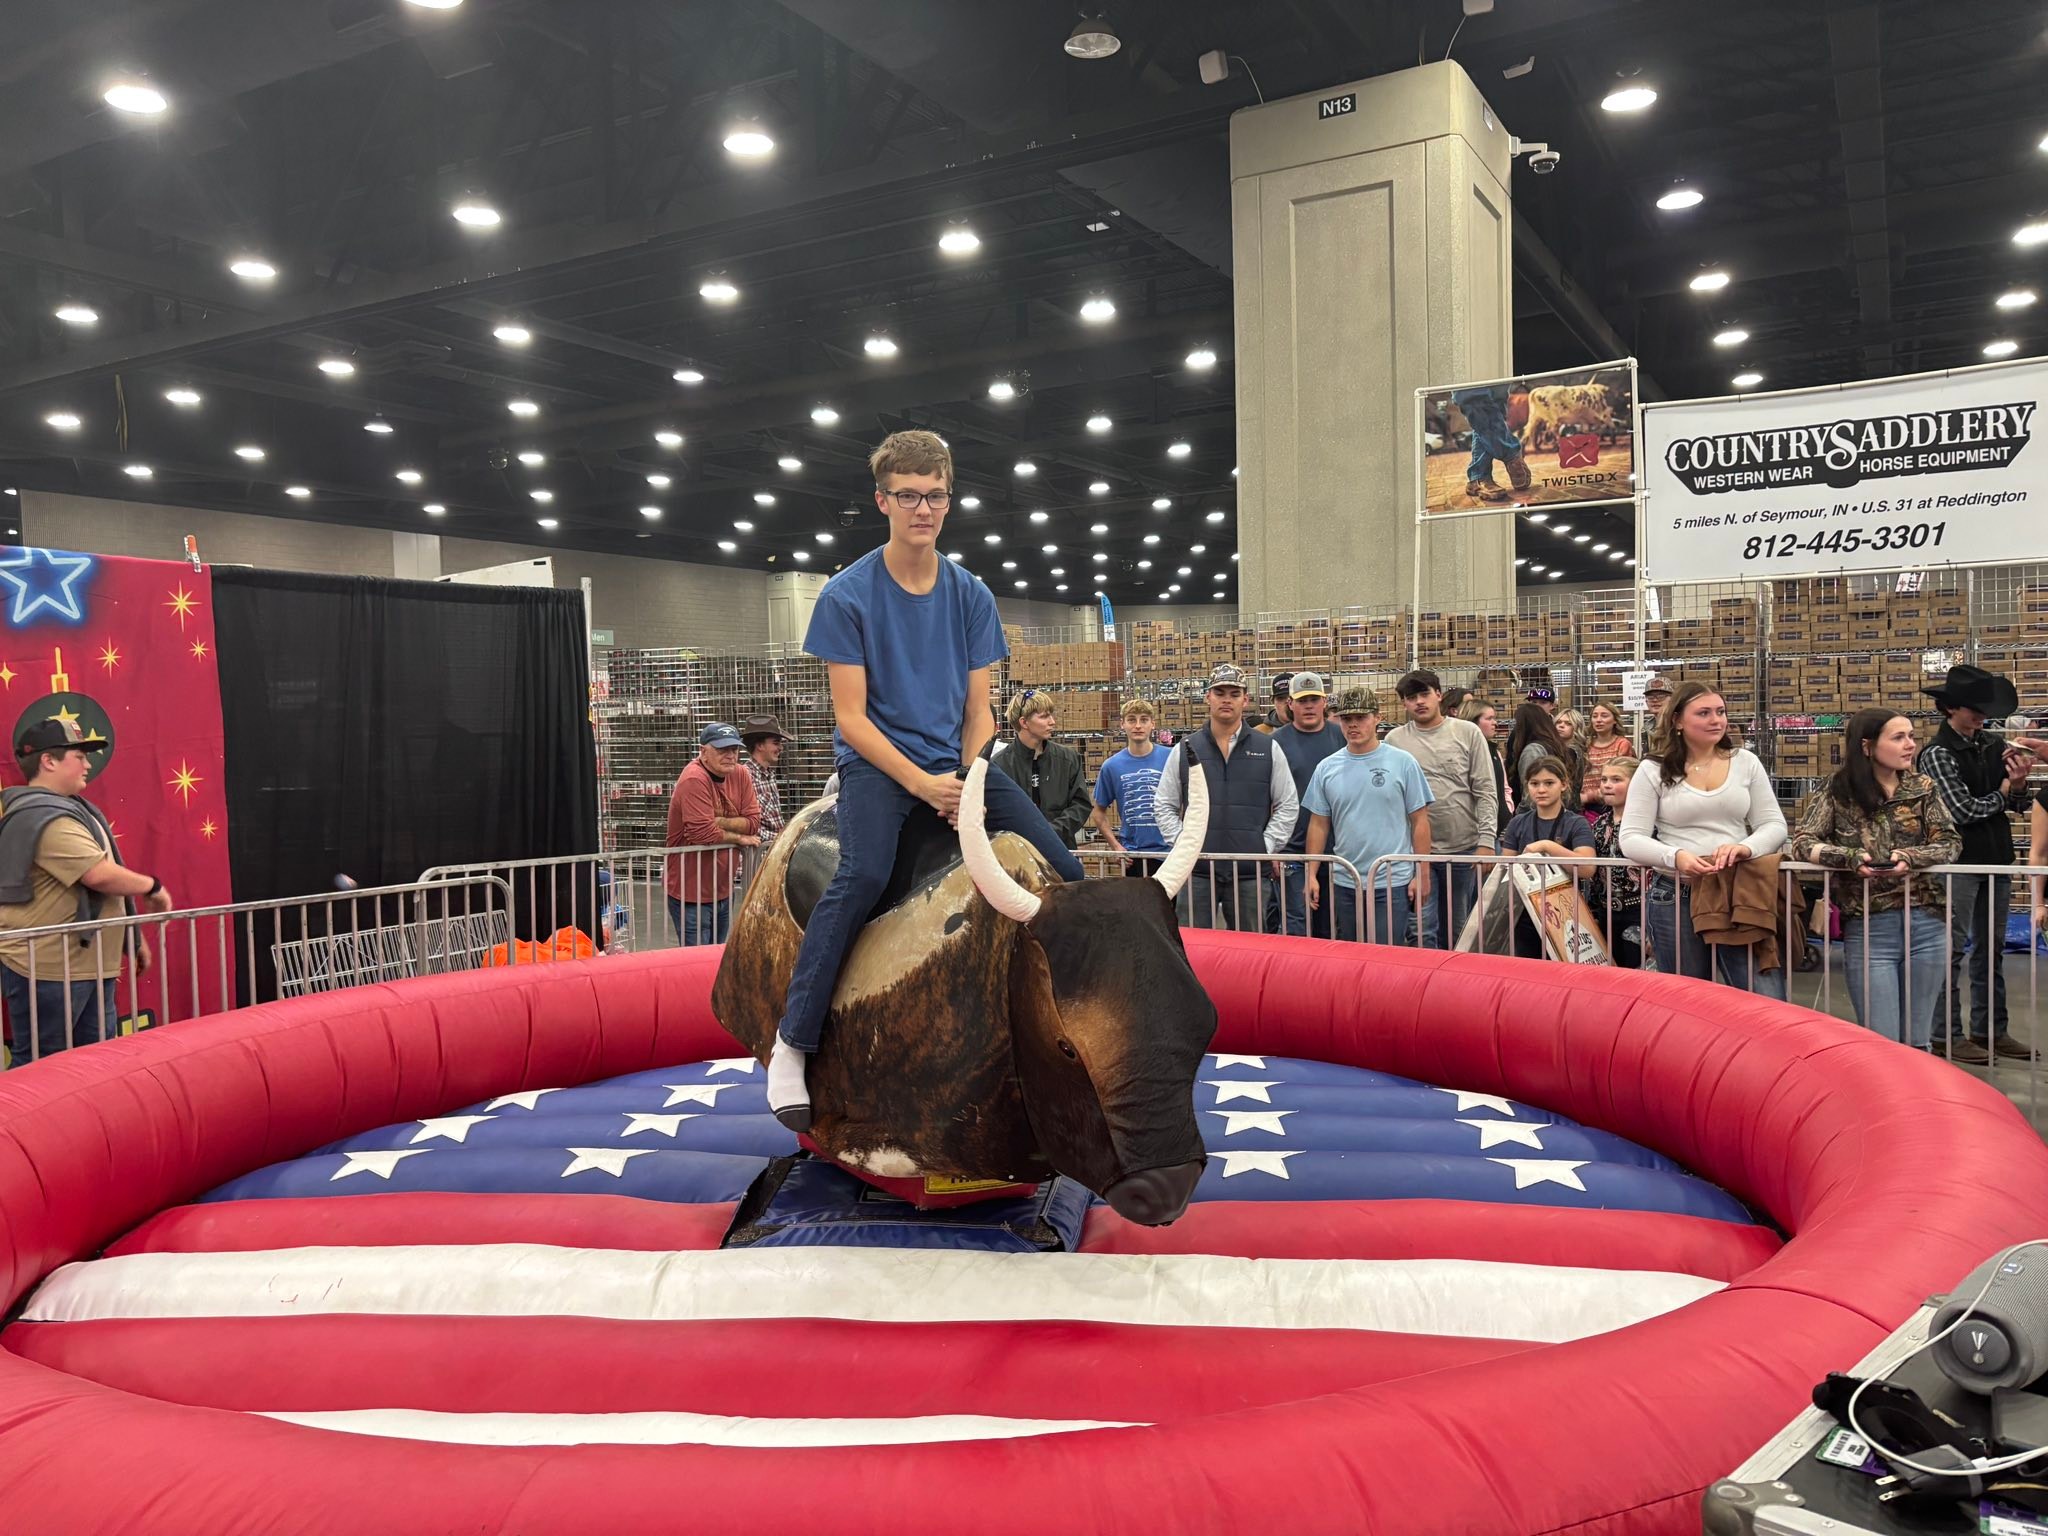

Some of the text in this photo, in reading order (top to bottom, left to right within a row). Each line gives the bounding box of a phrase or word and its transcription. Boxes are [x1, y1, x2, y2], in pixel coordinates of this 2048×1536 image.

[1323, 97, 1352, 116] N13
[1860, 446, 2011, 473] HORSE EQUIPMENT
[1542, 472, 1617, 488] TWISTED X
[1694, 466, 1813, 489] WESTERN WEAR
[1673, 491, 2027, 529] 5 miles N. of Seymour, IN U.S. 31 at Reddington
[1743, 521, 1946, 560] 812-445-3301
